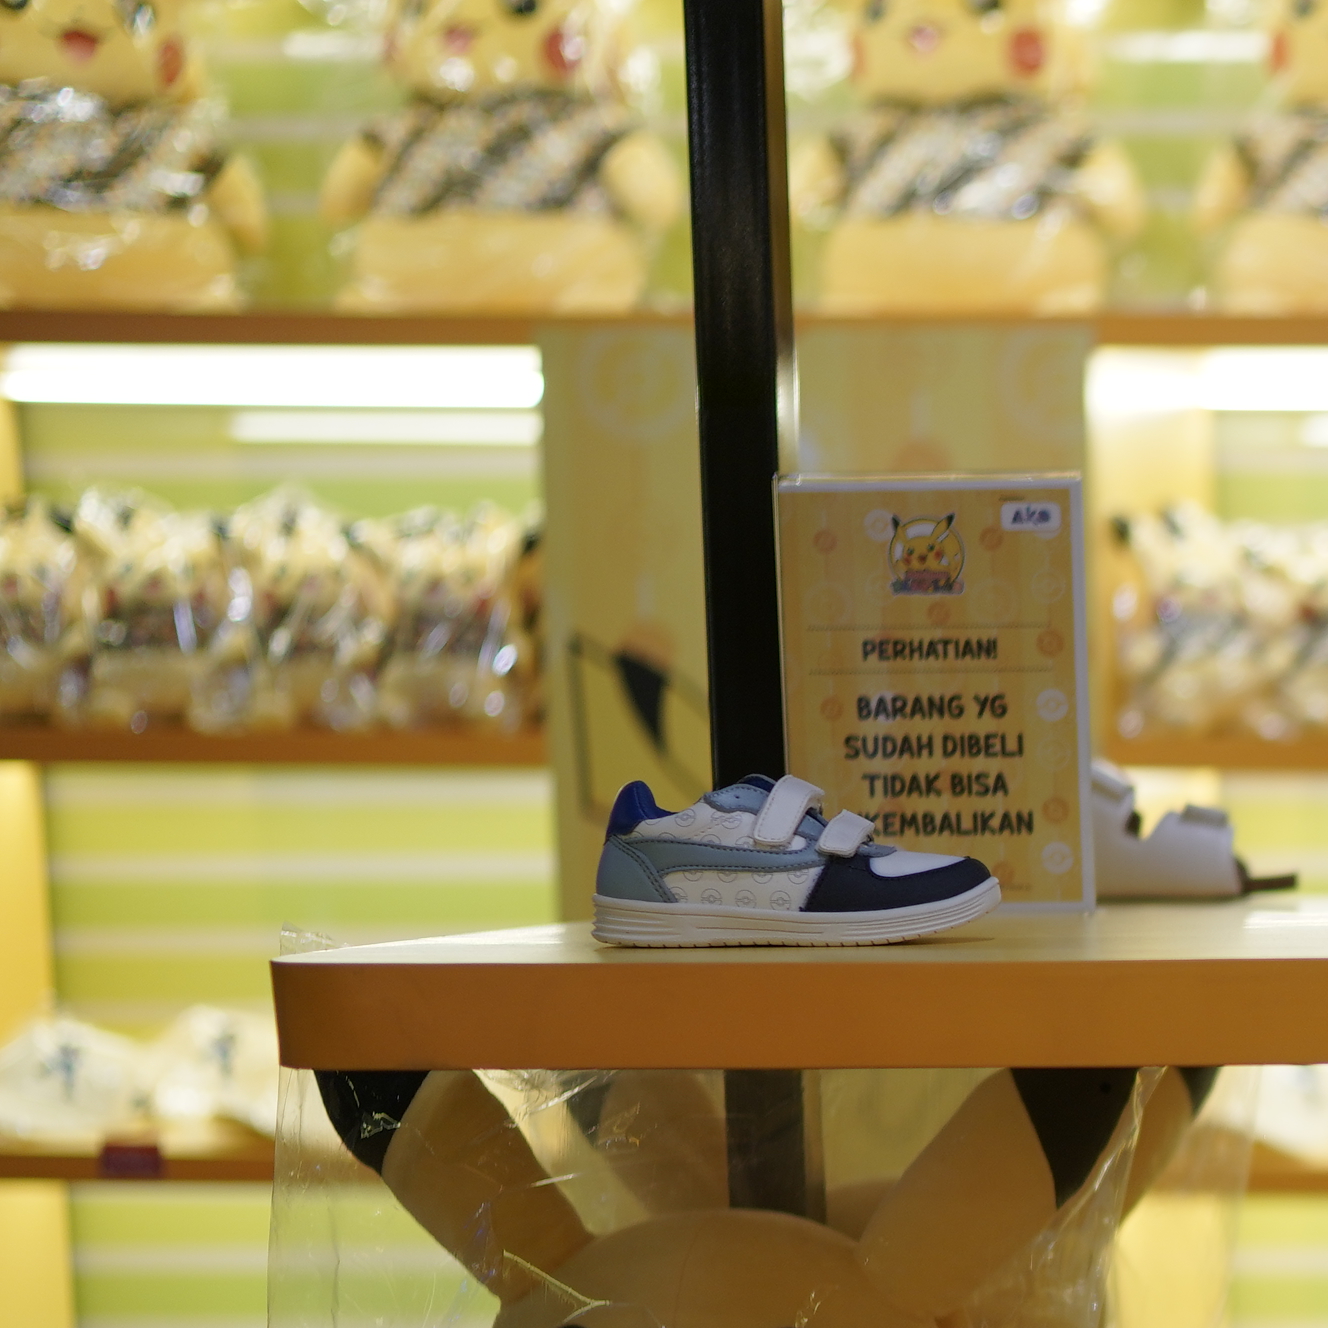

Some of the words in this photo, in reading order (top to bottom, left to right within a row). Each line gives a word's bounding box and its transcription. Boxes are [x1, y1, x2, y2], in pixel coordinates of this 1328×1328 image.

[862, 638, 998, 661] PERHATIAN!
[856, 693, 965, 721] BARANG
[973, 693, 1008, 720] YG
[844, 734, 934, 760] SUDAH
[941, 732, 1024, 759] DIBELI
[861, 772, 942, 798] TIDAK
[950, 772, 1009, 798] BISA
[857, 810, 1034, 836] KEMBALIKAN
